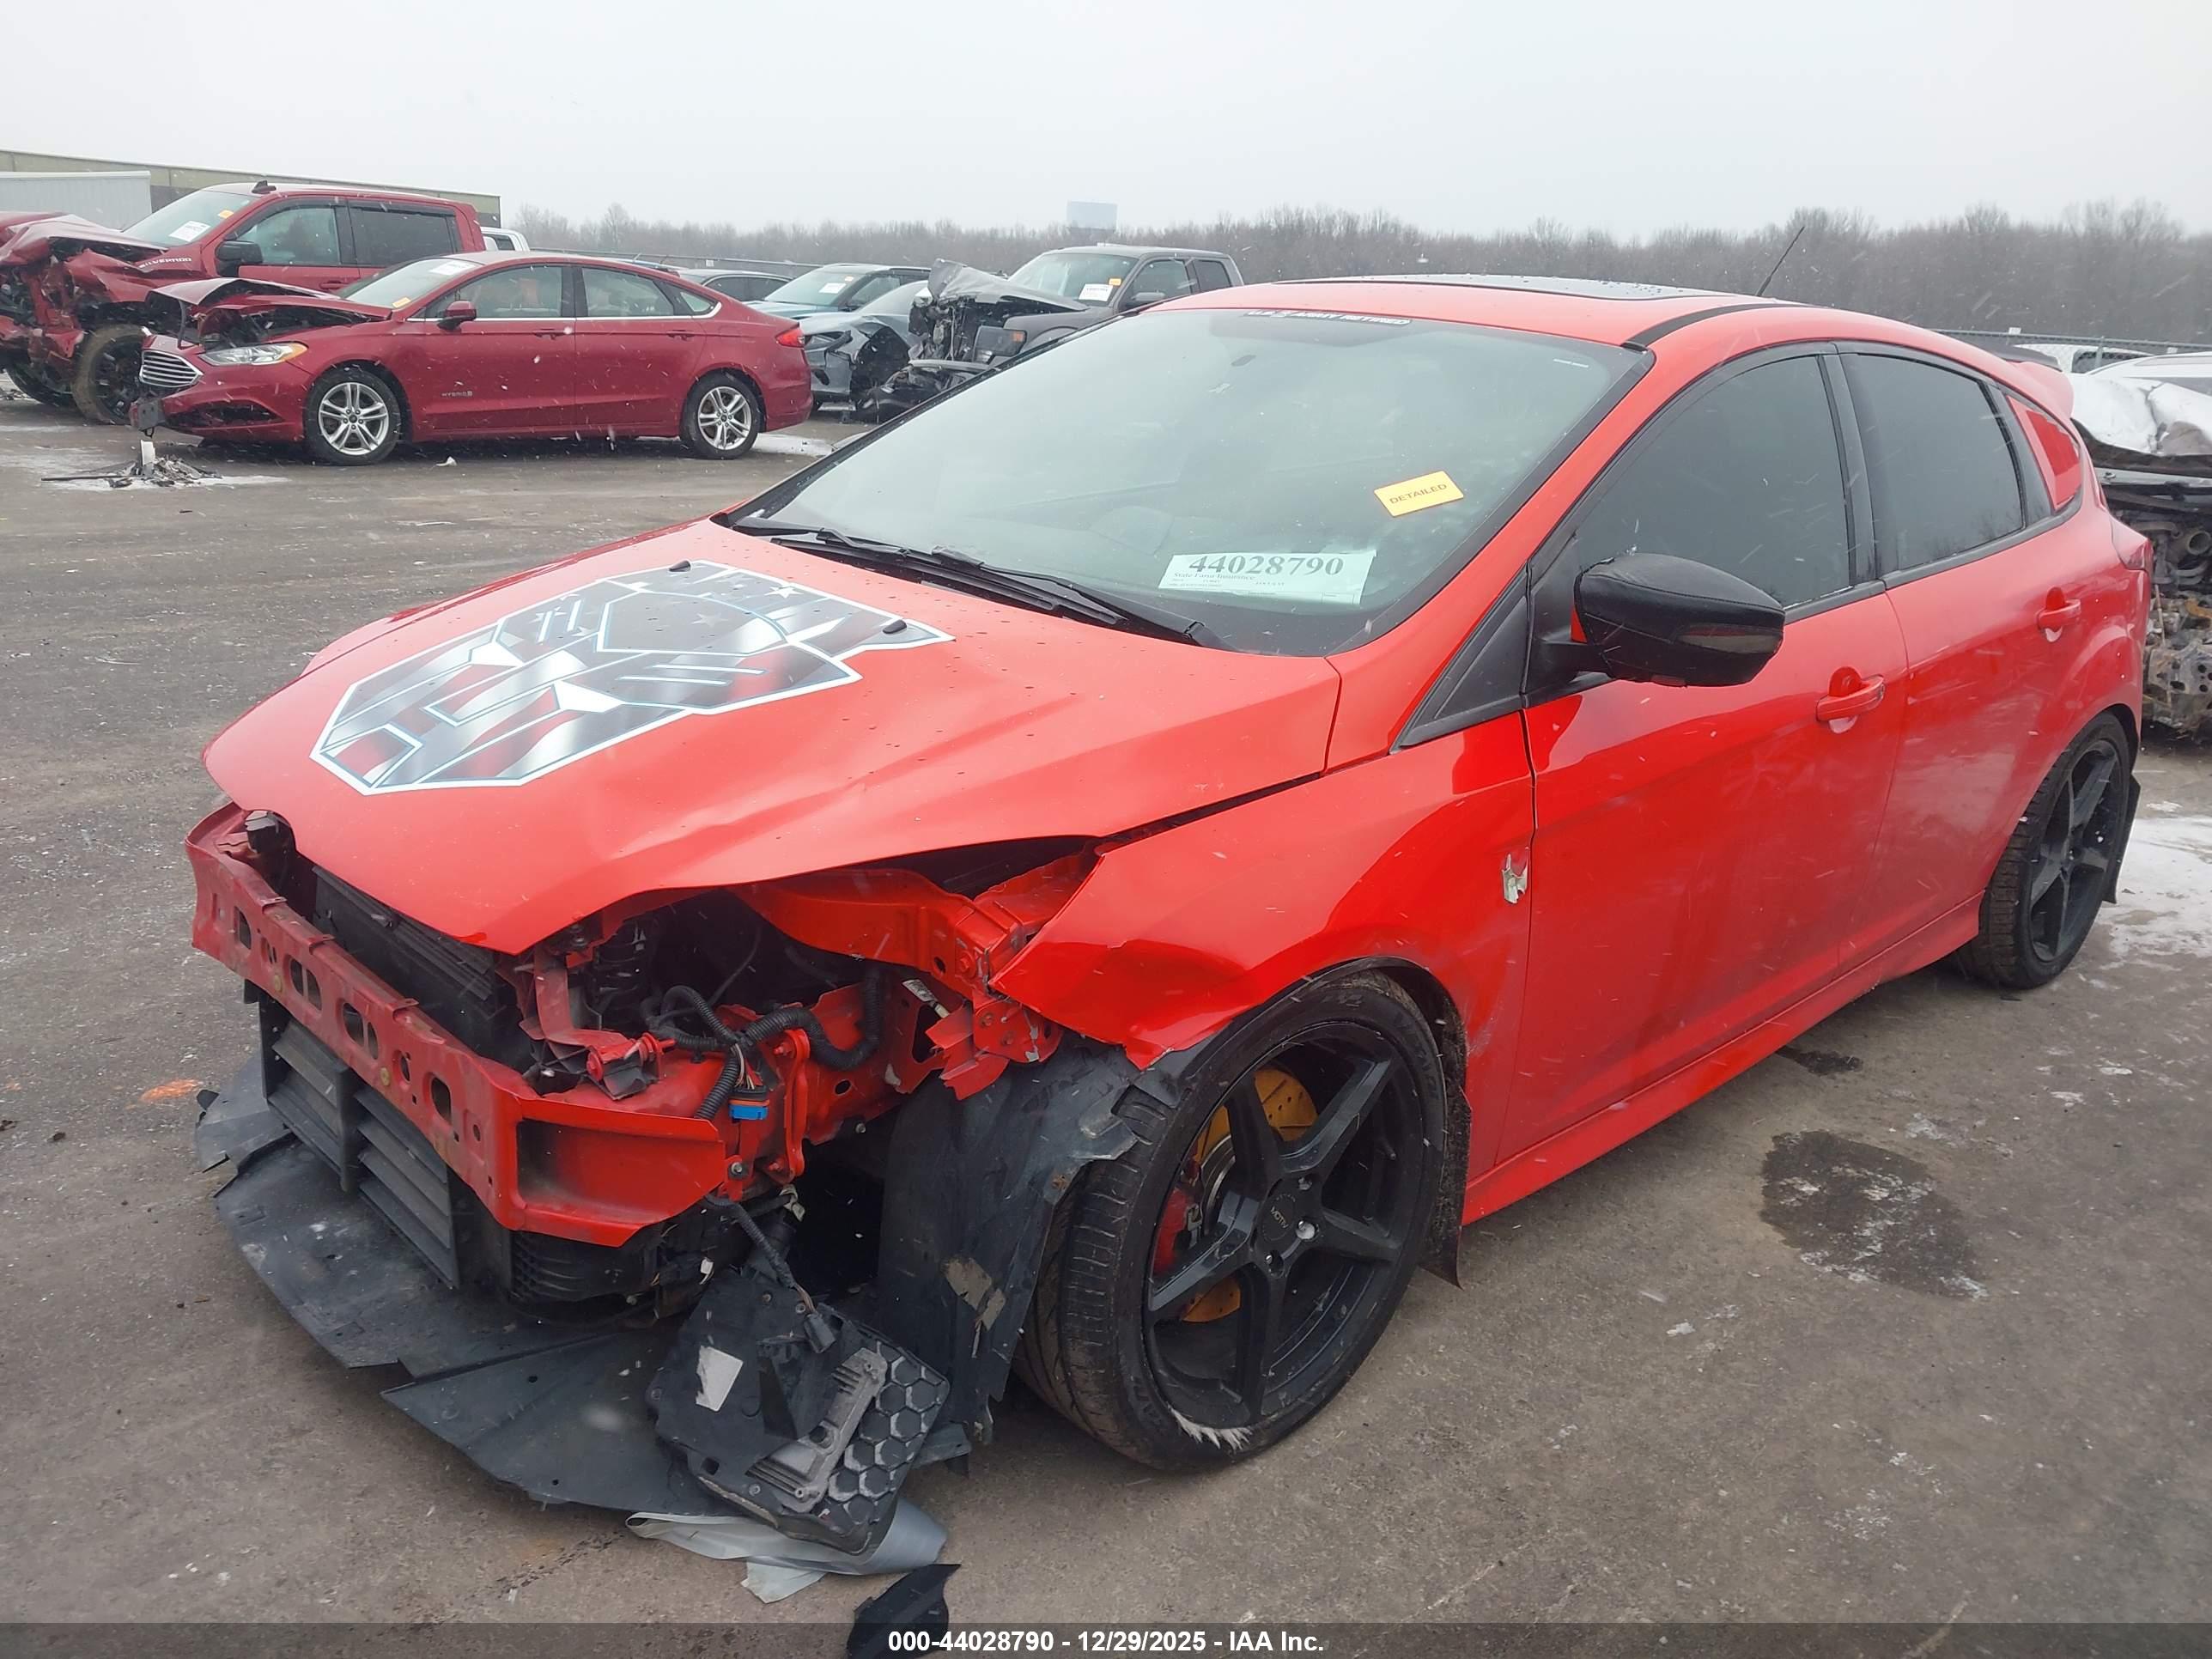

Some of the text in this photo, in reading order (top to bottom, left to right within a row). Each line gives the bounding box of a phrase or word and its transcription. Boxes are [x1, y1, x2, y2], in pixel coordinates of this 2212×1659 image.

[138, 257, 192, 269] SILVERADO
[1389, 483, 1447, 504] DETAILED
[1188, 556, 1344, 576] 44028790
